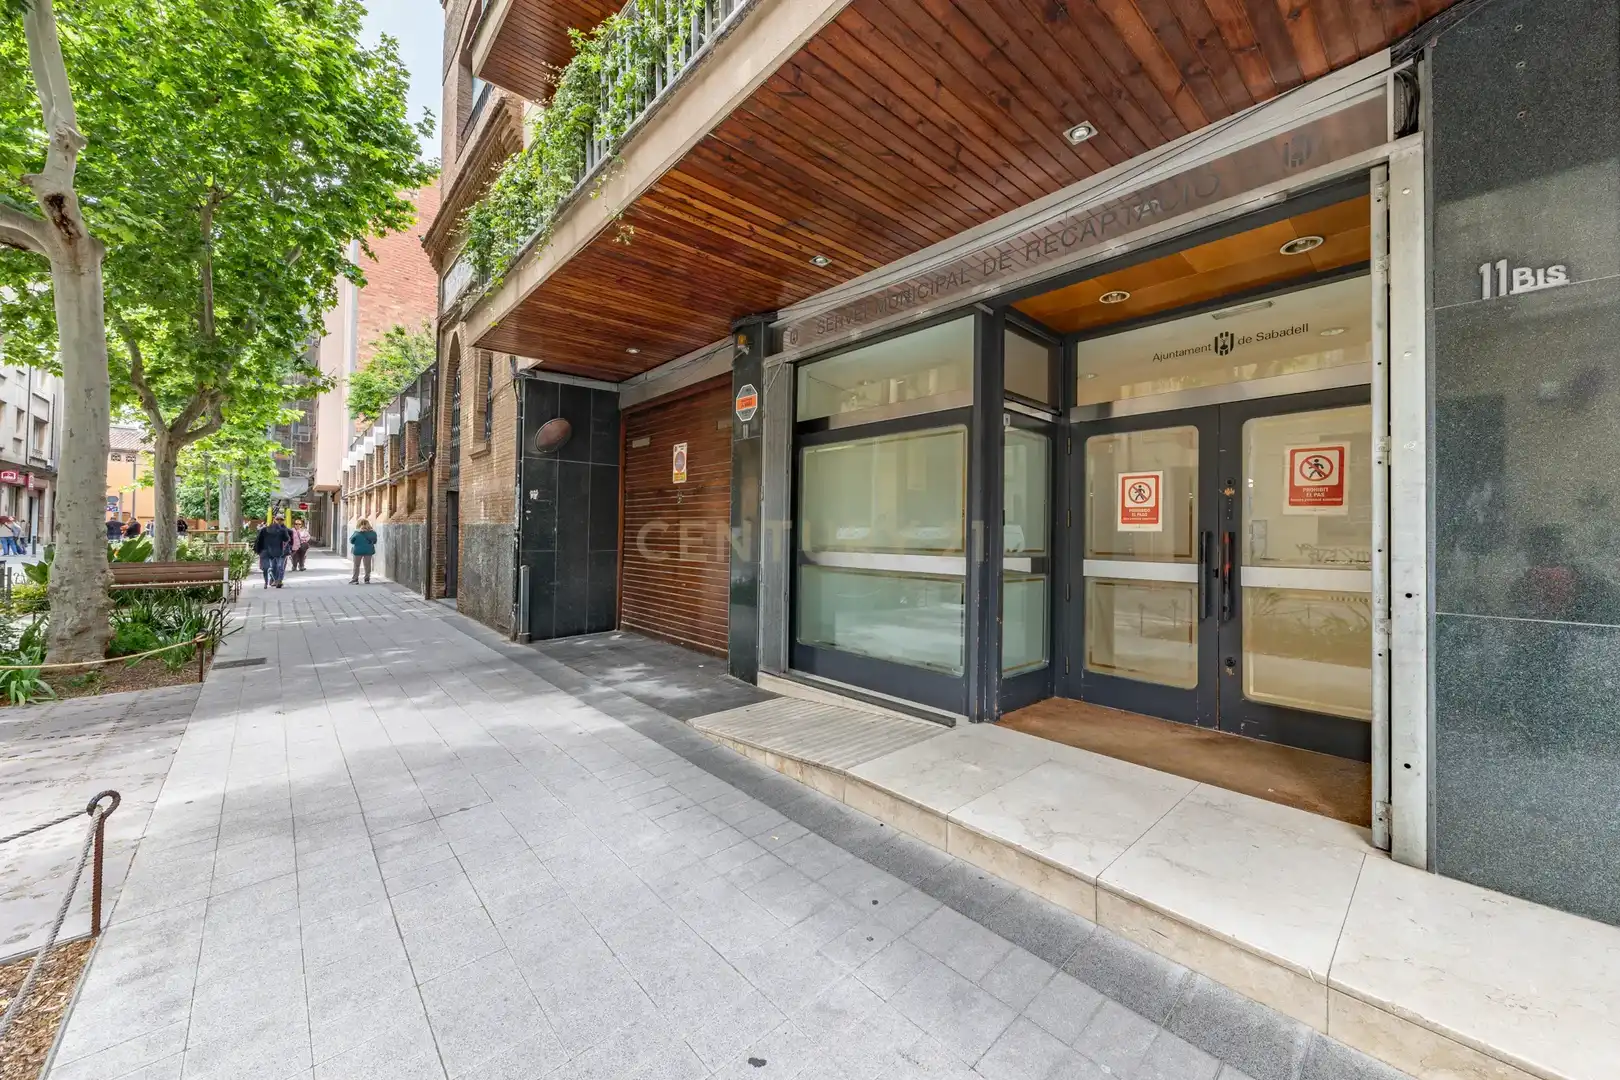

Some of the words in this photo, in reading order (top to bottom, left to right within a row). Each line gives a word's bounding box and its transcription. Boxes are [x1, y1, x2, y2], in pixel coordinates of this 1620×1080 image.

[816, 309, 868, 335] SERVEI
[875, 267, 971, 314] MUNICIPAL
[983, 251, 1012, 276] DE
[1152, 343, 1212, 363] Ajuntament
[1237, 335, 1253, 346] de
[1256, 323, 1309, 342] Sabadell
